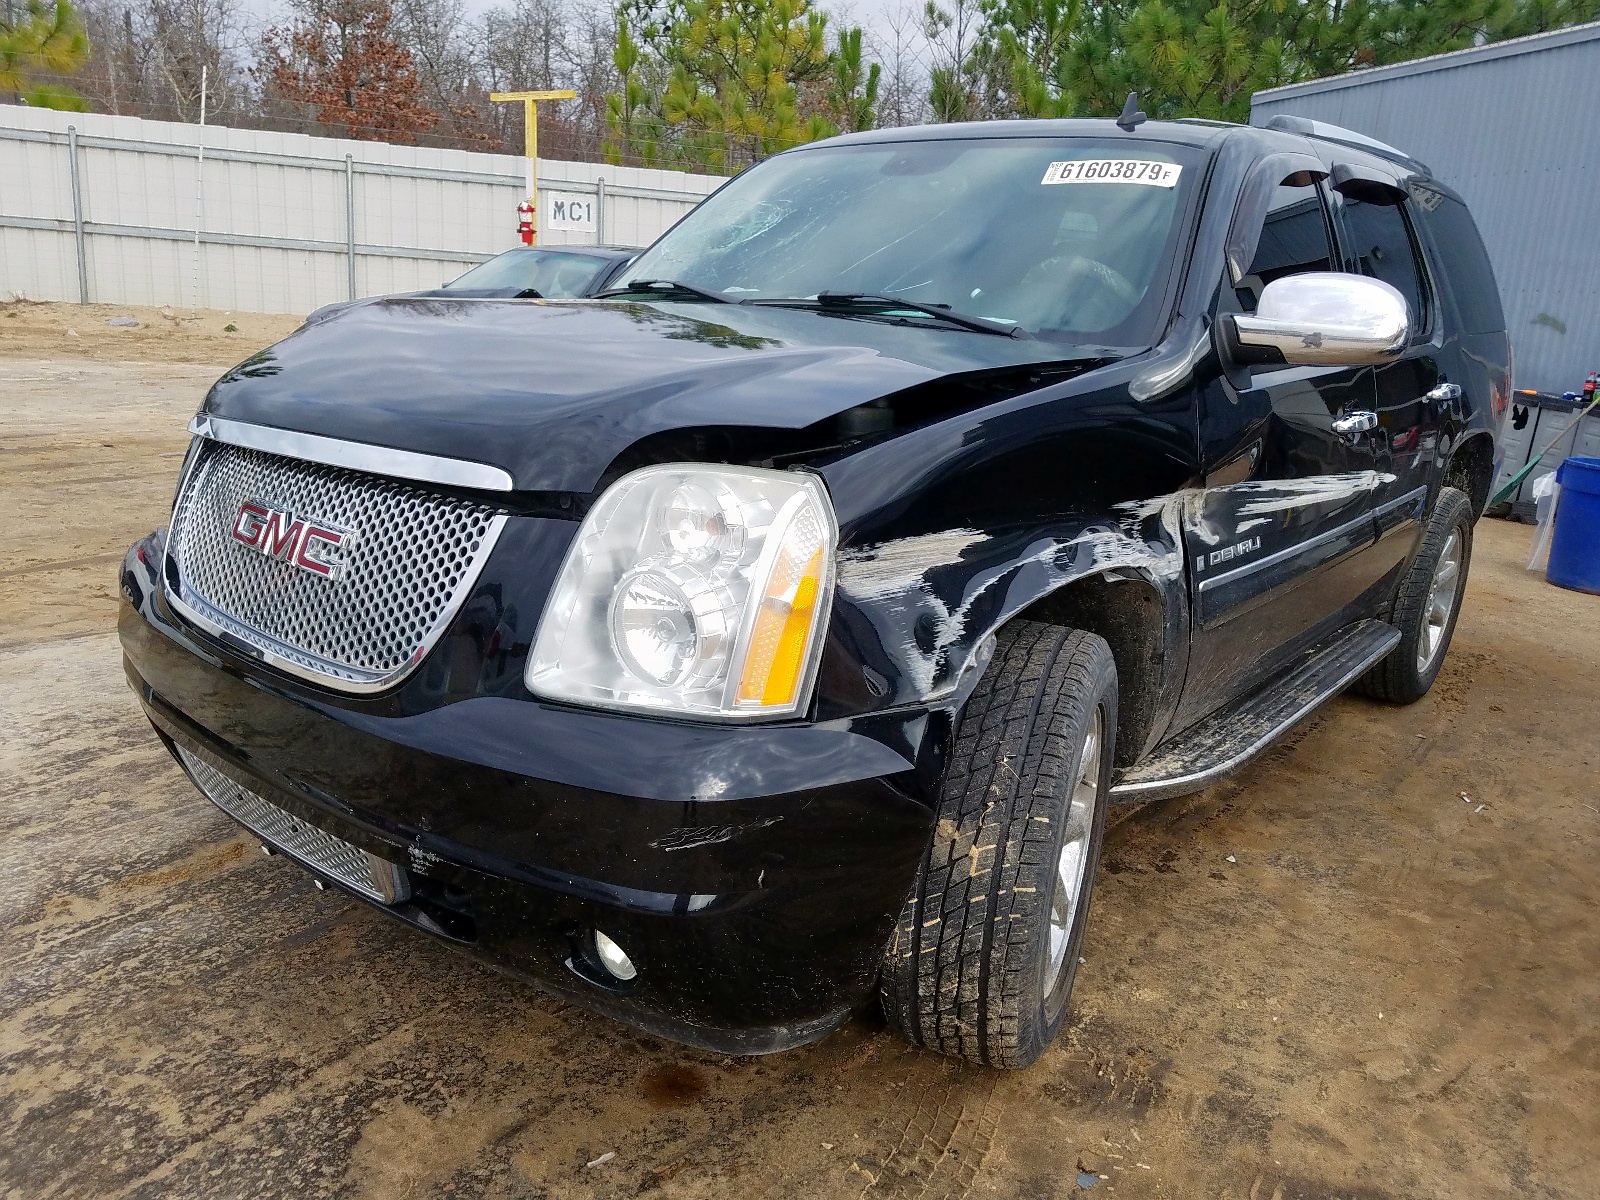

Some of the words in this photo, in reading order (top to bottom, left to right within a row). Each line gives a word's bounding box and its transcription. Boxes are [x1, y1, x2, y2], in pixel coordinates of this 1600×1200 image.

[553, 200, 591, 222] MC1
[232, 502, 346, 577] GMC
[1210, 536, 1261, 566] DENALI
